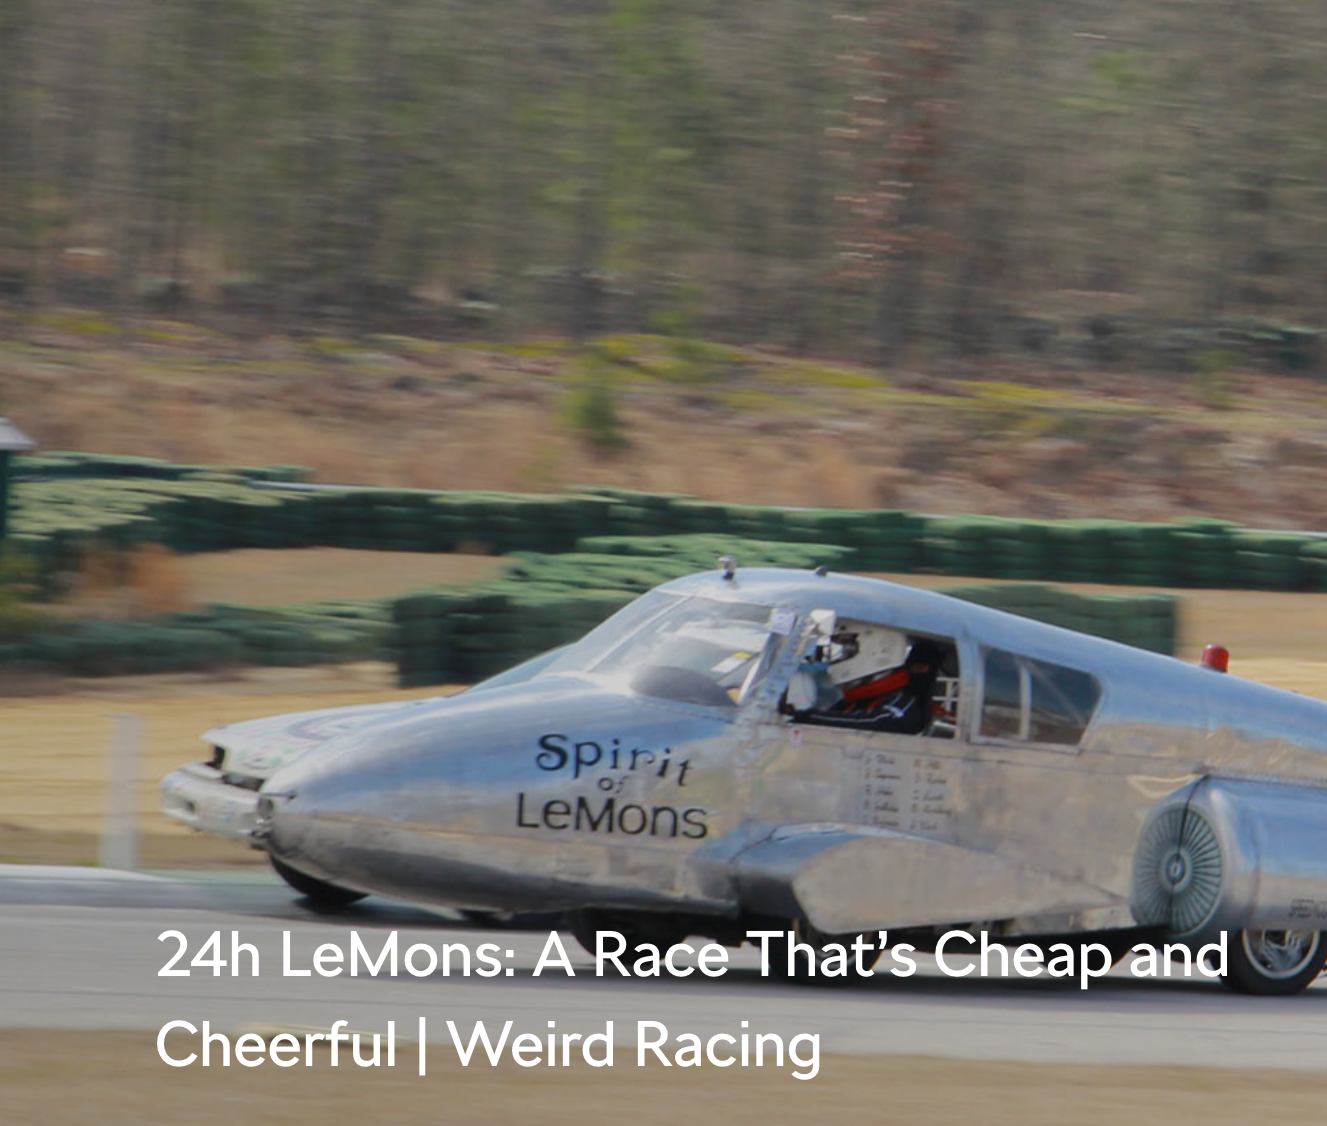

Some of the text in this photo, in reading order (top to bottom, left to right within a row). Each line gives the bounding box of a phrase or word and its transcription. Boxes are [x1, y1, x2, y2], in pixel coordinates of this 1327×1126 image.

[535, 733, 694, 787] Spirit
[597, 775, 632, 793] of
[516, 792, 709, 839] LeMons
